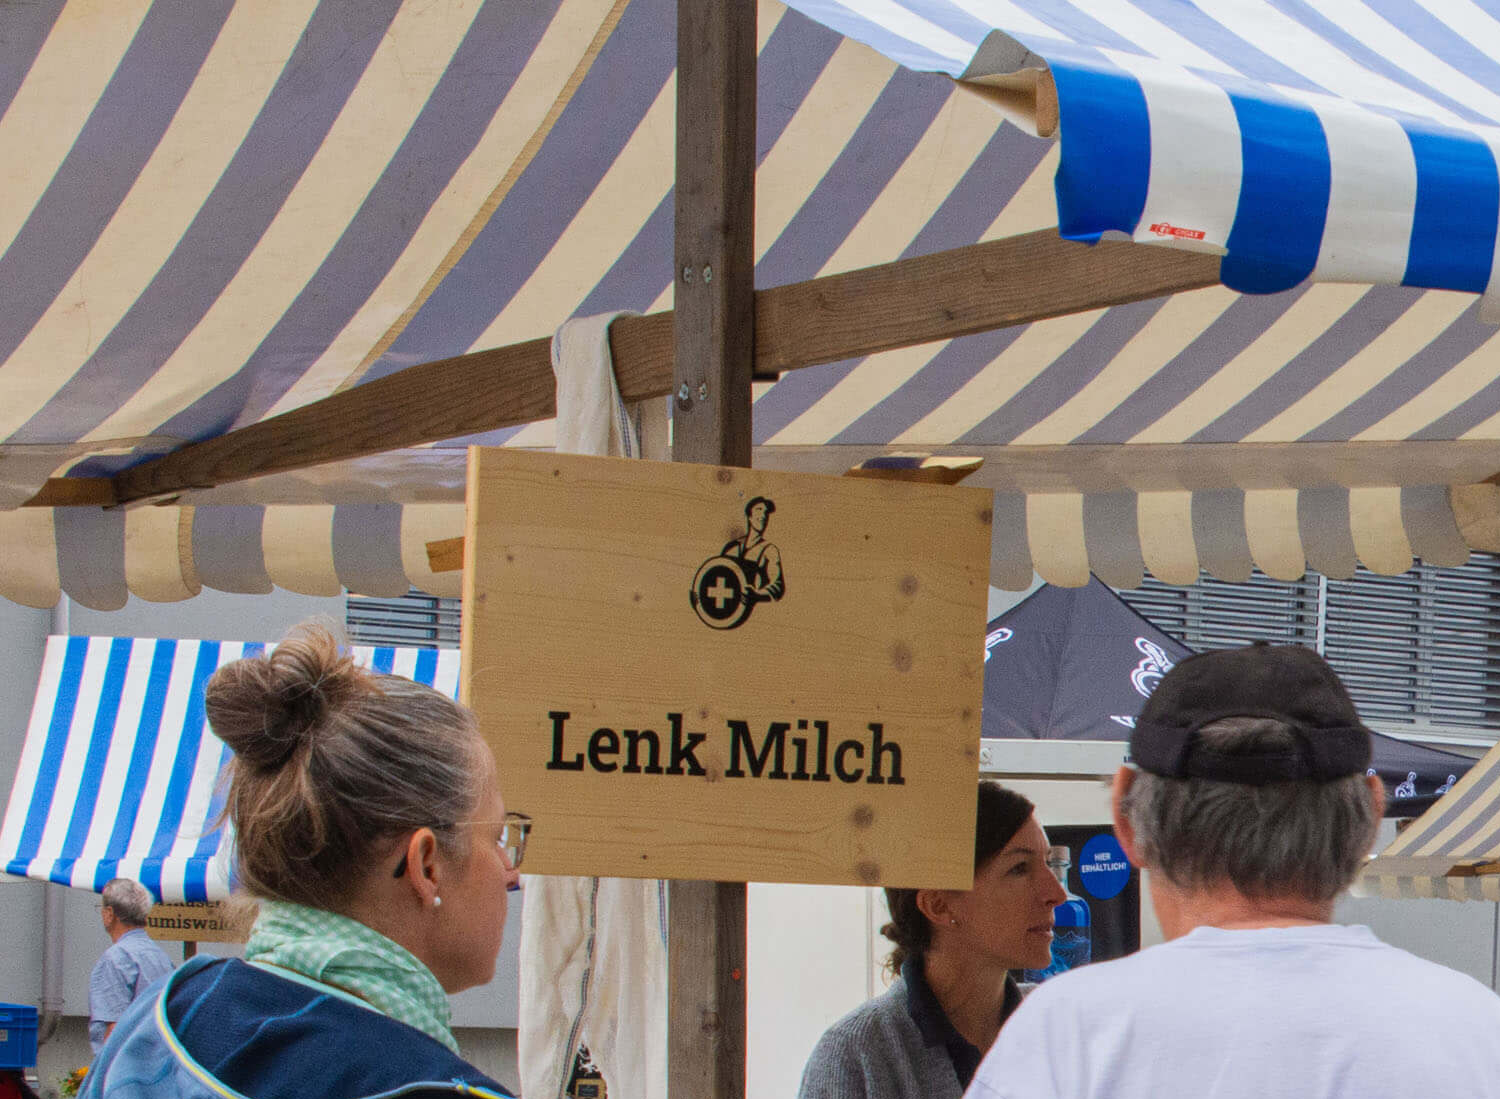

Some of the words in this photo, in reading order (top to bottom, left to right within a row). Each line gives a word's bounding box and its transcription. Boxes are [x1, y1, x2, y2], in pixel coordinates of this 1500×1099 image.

[545, 711, 707, 776] Lenk
[725, 719, 905, 785] Milch
[1094, 852, 1111, 861] HIER
[1081, 862, 1127, 874] ERHÄLTLICH!
